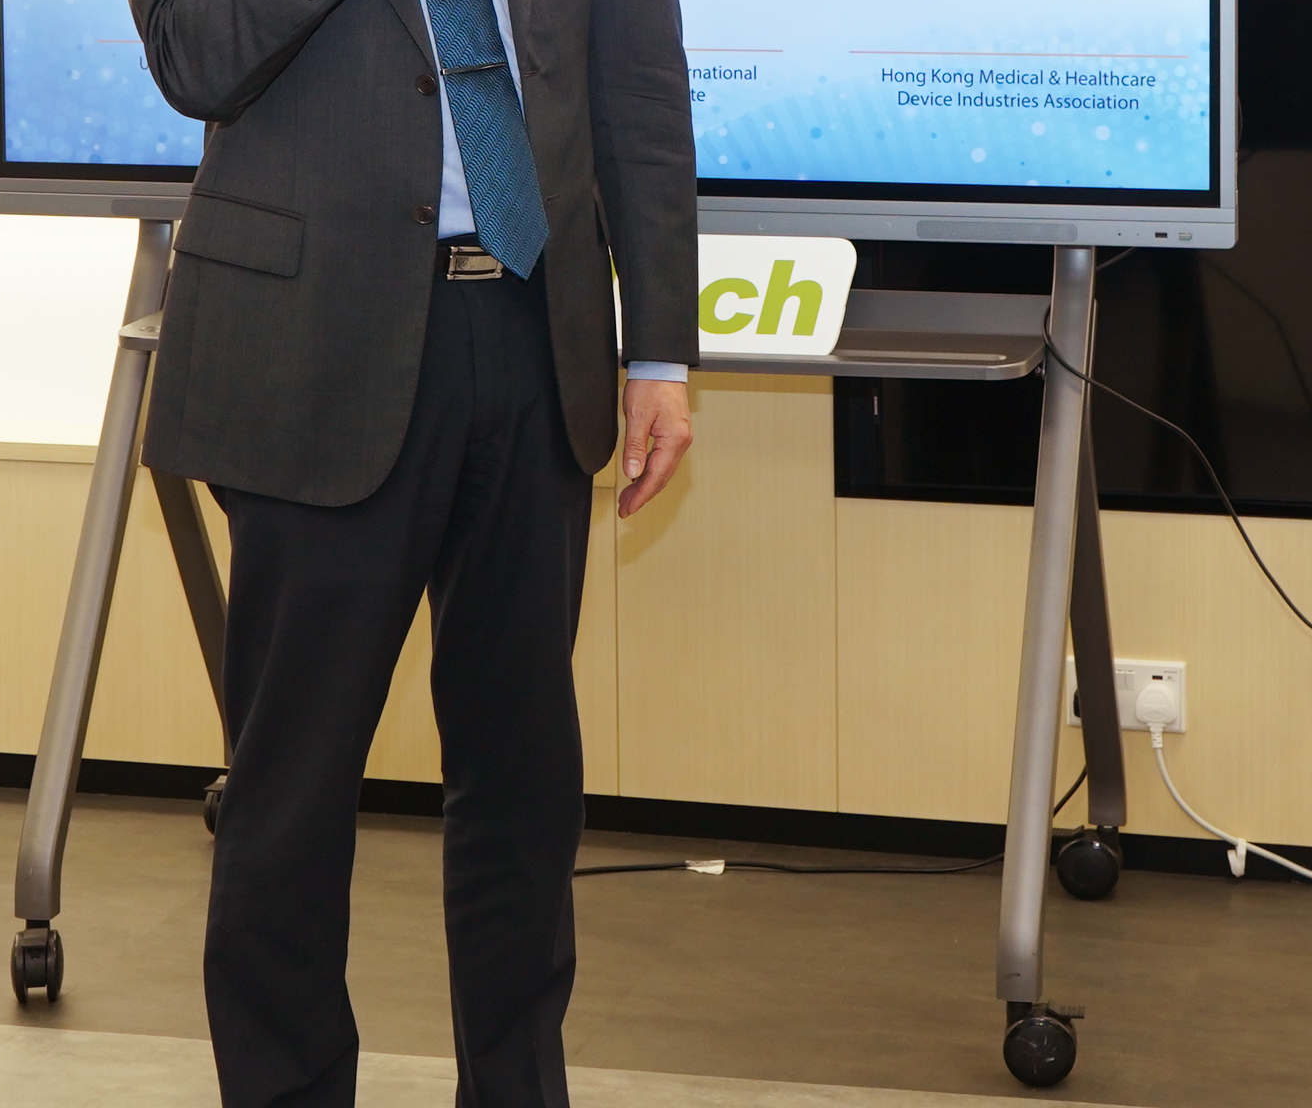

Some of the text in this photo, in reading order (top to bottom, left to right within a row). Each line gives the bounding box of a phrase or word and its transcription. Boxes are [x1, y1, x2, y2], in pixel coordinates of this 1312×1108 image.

[881, 68, 1156, 87] Hong Kong Medical & Healthcare
[897, 91, 1139, 110] Device Industries Association
